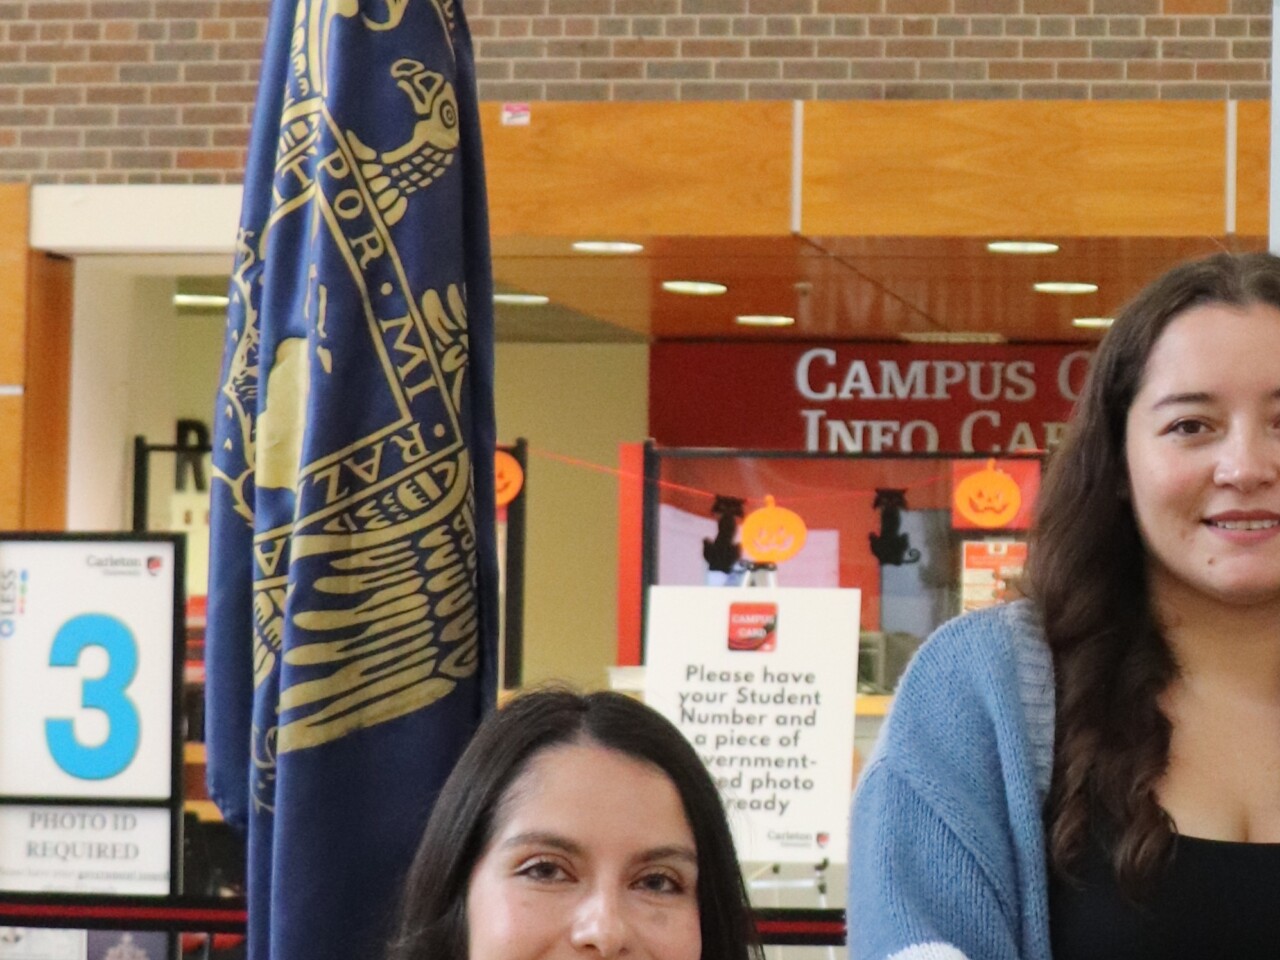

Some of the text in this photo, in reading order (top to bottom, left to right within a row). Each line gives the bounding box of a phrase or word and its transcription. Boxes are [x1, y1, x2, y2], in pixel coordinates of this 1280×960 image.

[316, 149, 439, 404] POR MI
[794, 347, 1036, 400] CAMPUS
[801, 409, 939, 452] INFO
[685, 664, 816, 684] Please have
[44, 611, 141, 780] 3
[678, 687, 822, 708] your Student
[680, 707, 817, 727] Number and
[694, 729, 802, 750] a piece of
[702, 753, 818, 769] vernment-
[750, 770, 815, 793] photo
[726, 793, 790, 816] ready
[28, 810, 137, 831] PHOTO ID
[26, 840, 140, 861] REQUIRED
